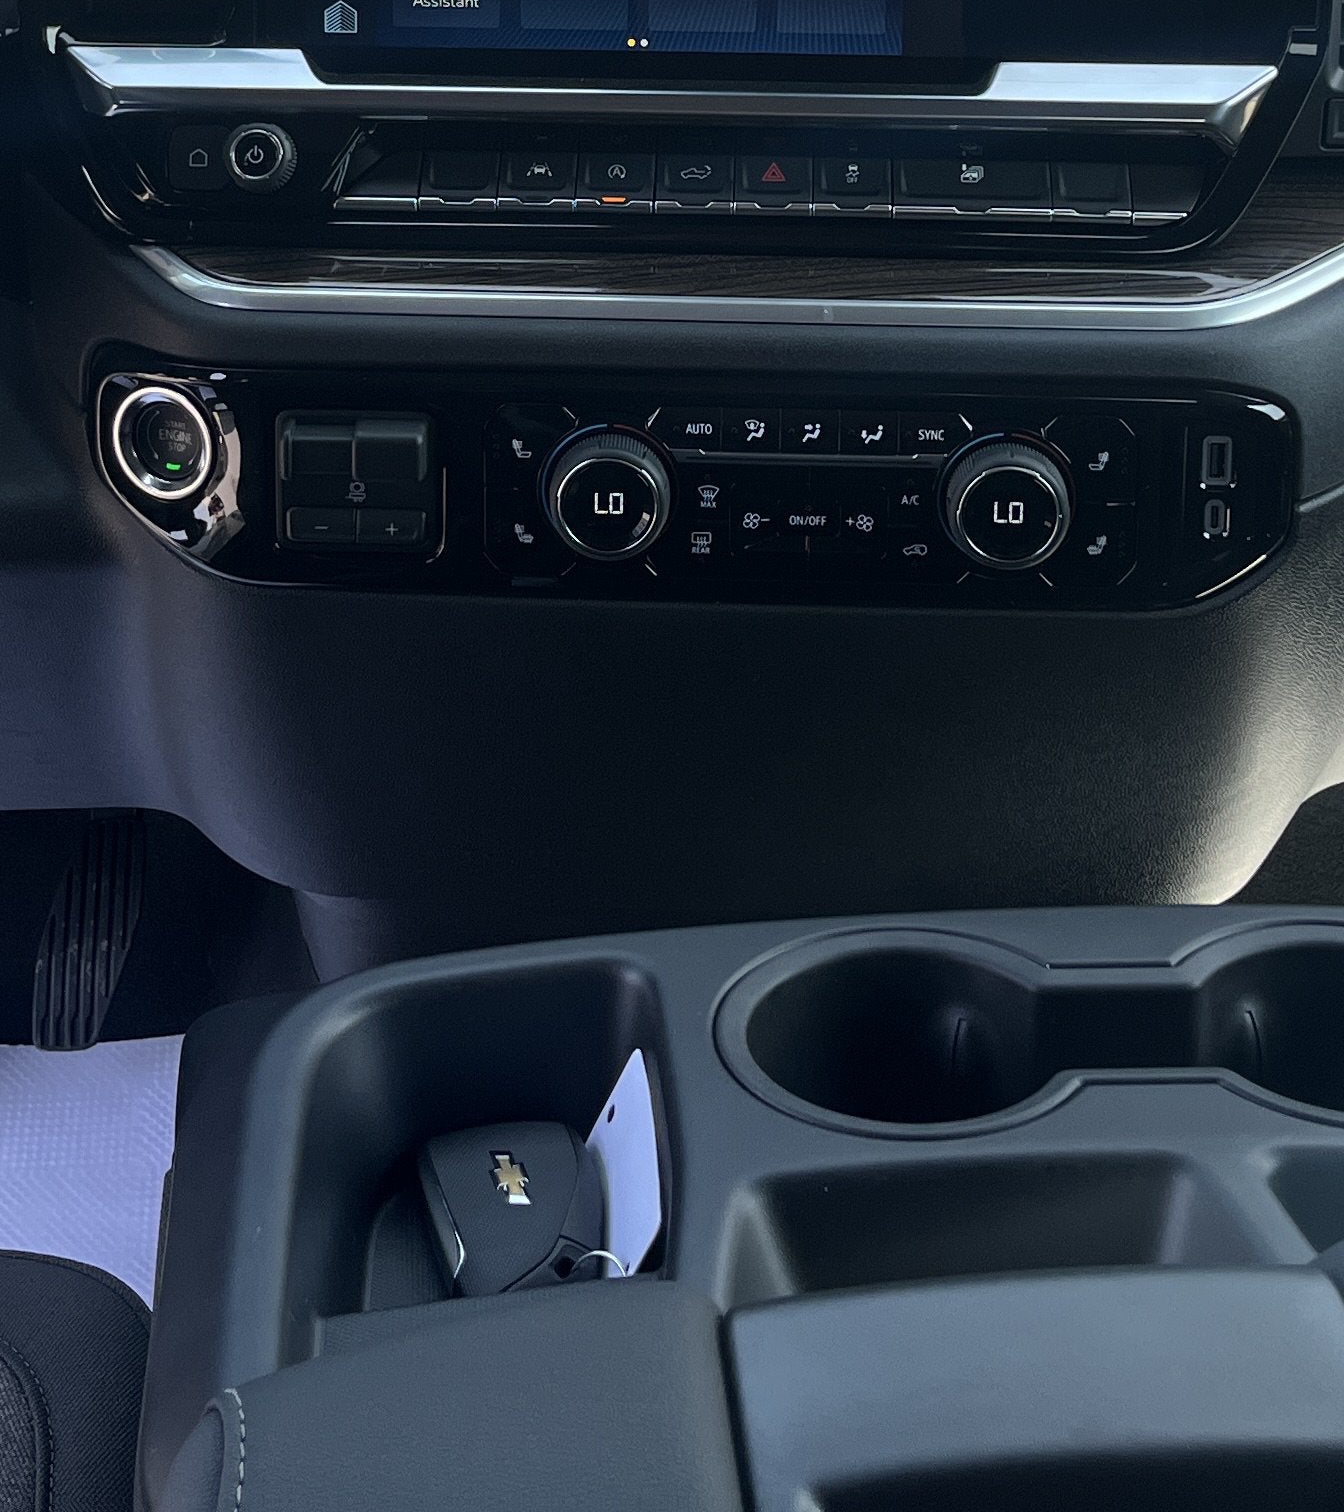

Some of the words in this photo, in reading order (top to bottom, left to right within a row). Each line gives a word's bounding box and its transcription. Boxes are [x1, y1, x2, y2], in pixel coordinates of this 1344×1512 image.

[685, 424, 713, 435] AUTO
[918, 429, 945, 441] SYNC
[158, 429, 192, 445] ENGINE
[901, 495, 920, 506] A/C
[789, 515, 827, 527] ON/OFF
